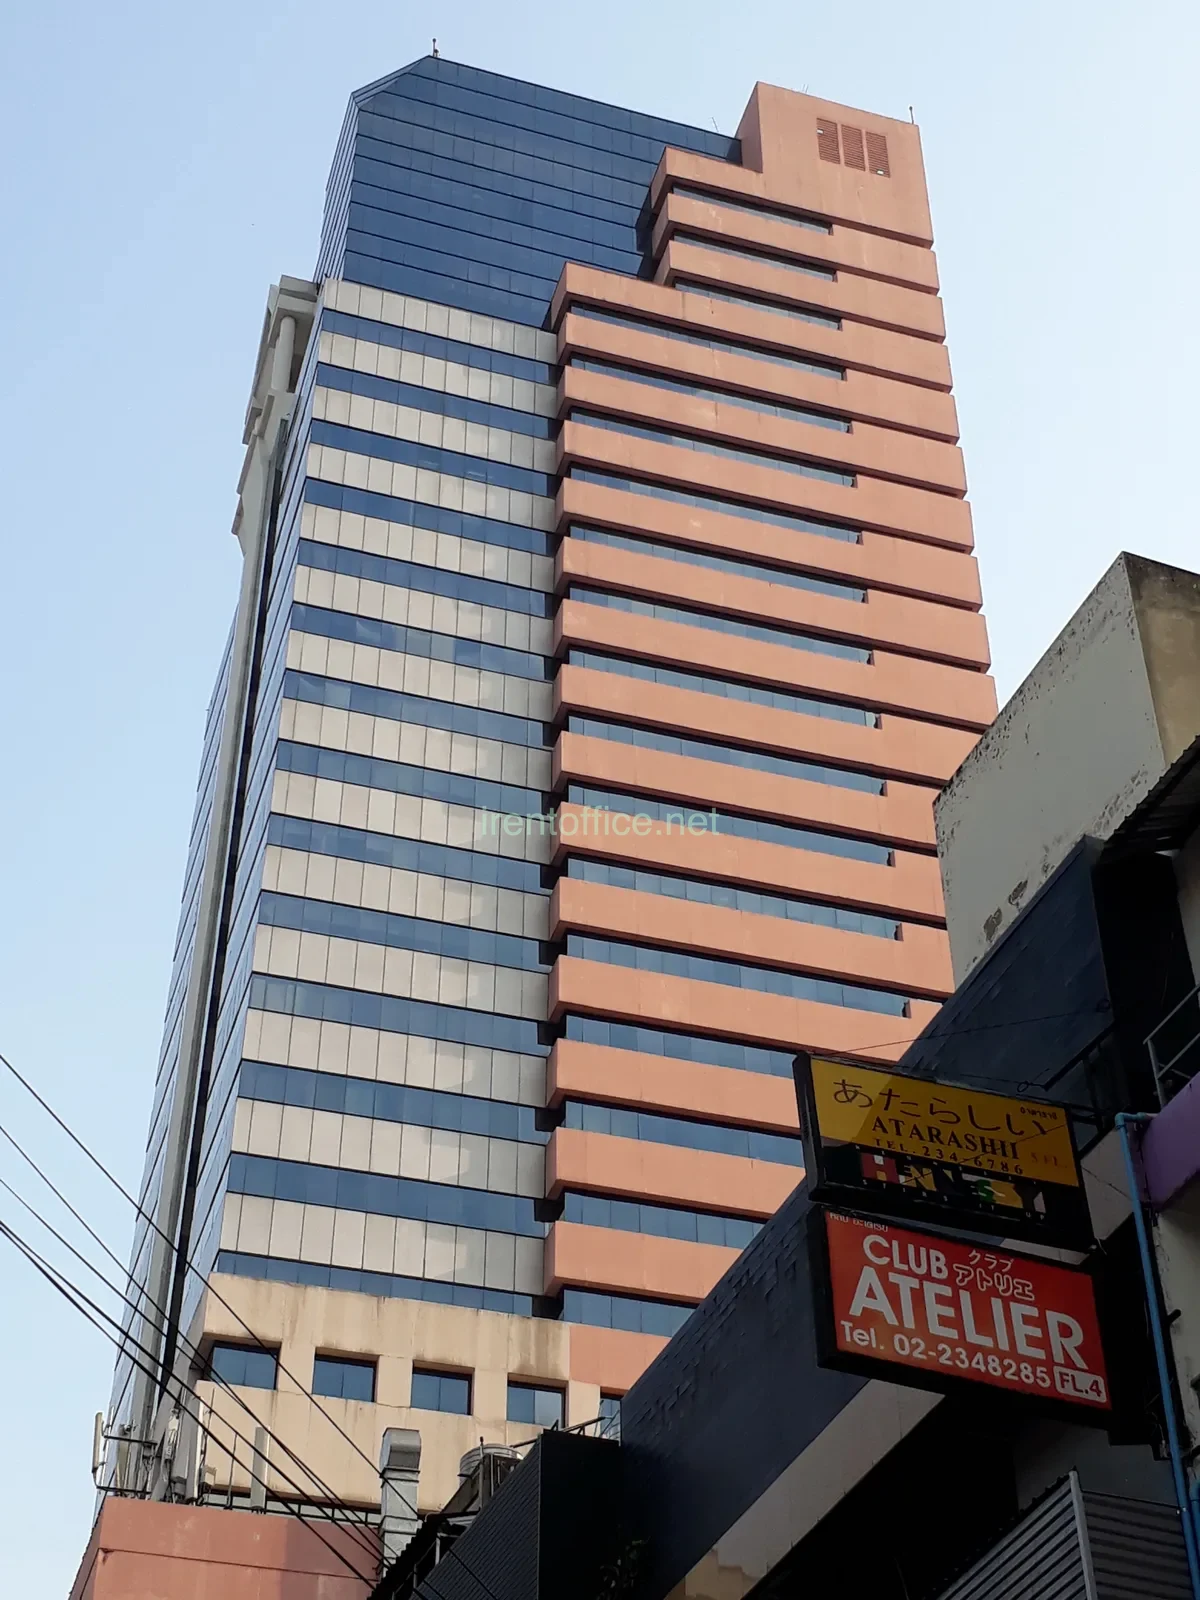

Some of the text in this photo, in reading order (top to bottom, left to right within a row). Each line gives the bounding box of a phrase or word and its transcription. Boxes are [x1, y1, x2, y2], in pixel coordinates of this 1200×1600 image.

[833, 1079, 1048, 1136] あたらしい
[871, 1116, 1020, 1161] ATARASHII
[863, 1234, 949, 1281] CLUB
[968, 1249, 1015, 1273] クラブ
[952, 1263, 1036, 1302] アトリエ
[849, 1266, 1089, 1371] ATELIER
[840, 1319, 1103, 1398] Tel. 02-2348285 FL.4
